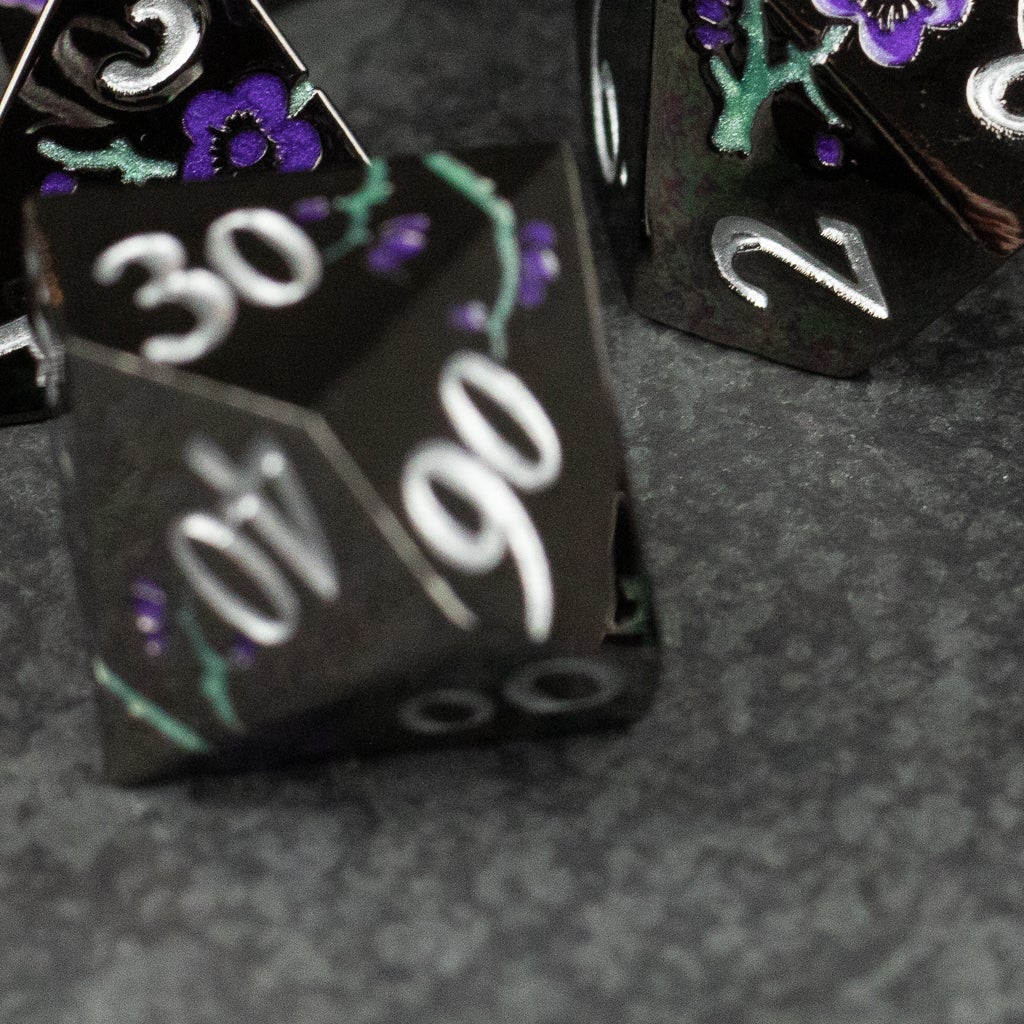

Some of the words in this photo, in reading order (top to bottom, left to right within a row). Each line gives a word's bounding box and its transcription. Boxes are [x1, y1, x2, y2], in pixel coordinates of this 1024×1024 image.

[95, 207, 323, 364] 30
[711, 217, 889, 319] 2
[174, 432, 340, 646] 40
[402, 352, 562, 644] 90
